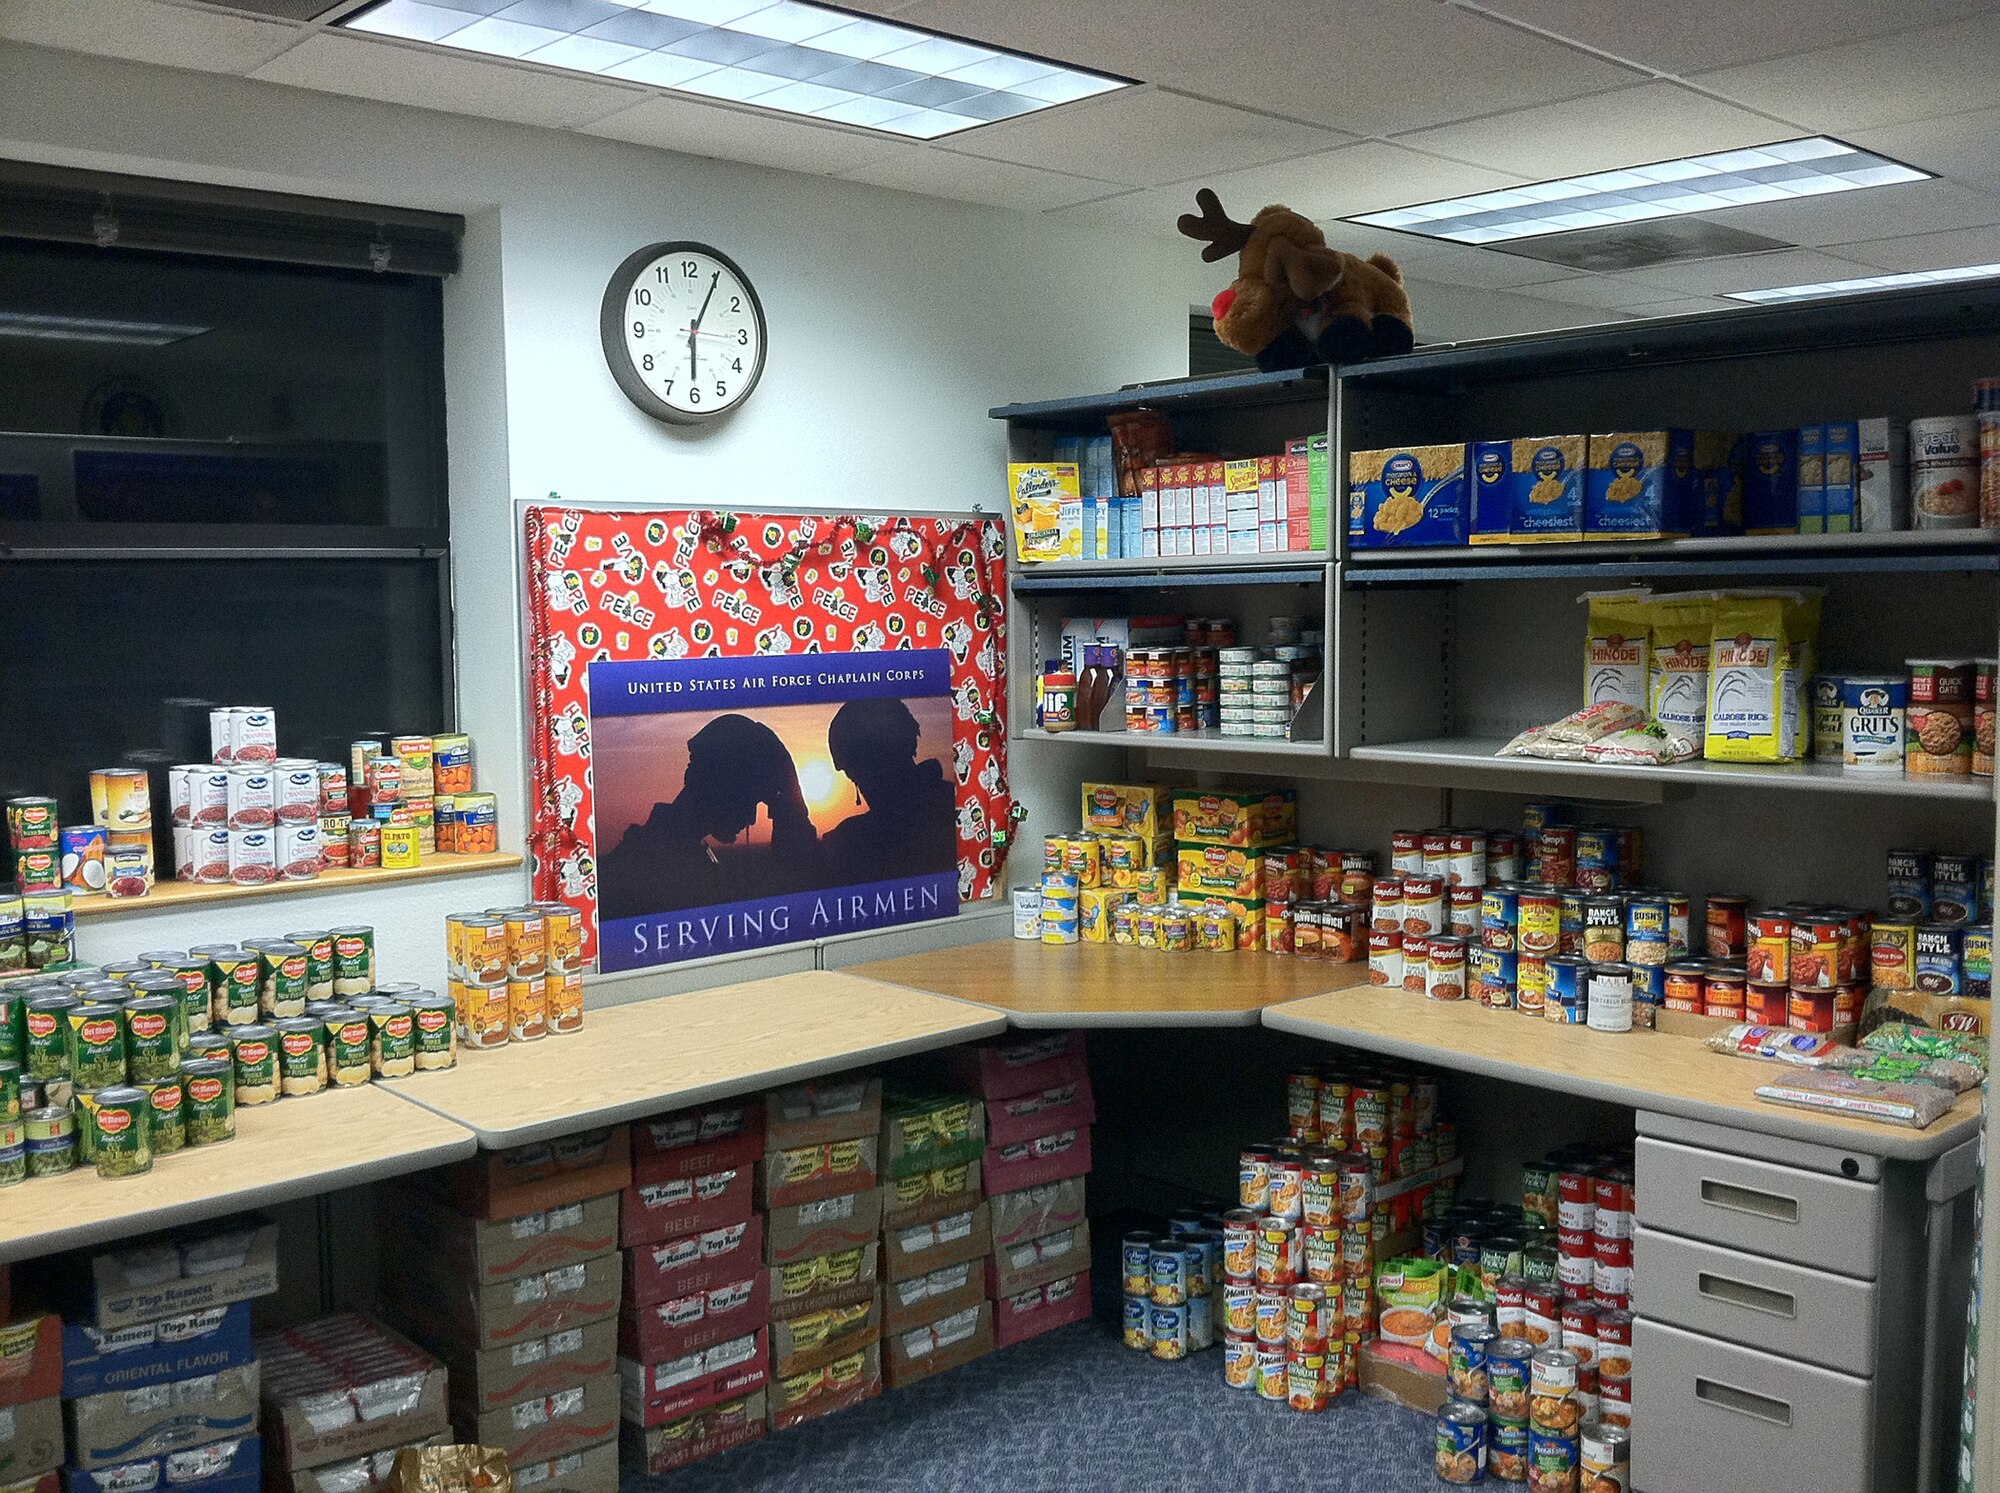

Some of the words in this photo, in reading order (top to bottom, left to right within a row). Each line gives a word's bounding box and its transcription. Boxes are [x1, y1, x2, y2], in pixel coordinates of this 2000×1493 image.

[656, 267, 669, 283] 11
[681, 261, 698, 278] 12
[635, 289, 651, 306] 10
[730, 296, 741, 313] 2
[633, 322, 645, 338] 9
[737, 329, 748, 345] 3
[643, 354, 654, 371] 8
[732, 357, 743, 374] 4
[664, 379, 674, 395] 7
[716, 381, 727, 396] 5
[690, 388, 700, 404] 6
[1915, 429, 1959, 446] Great
[1924, 443, 1961, 455] Value
[1428, 508, 1439, 518] 12
[1524, 516, 1574, 528] cheesiest
[713, 590, 759, 626] PEACE
[813, 589, 857, 621] PEACE
[905, 586, 946, 618] PEACE
[602, 593, 653, 628] PEACE
[1592, 649, 1639, 662] HINODE
[628, 681, 683, 696] UNITED
[689, 677, 736, 692] STATES
[742, 675, 766, 689] AIR
[772, 673, 813, 688] FORCE
[817, 670, 881, 686] CHAPLAIN
[886, 668, 925, 682] CORPS
[1939, 677, 1962, 686] QUICK
[1939, 685, 1959, 694] OATS
[1714, 712, 1746, 721] CALROSE
[1747, 713, 1769, 721] RICE
[1850, 716, 1899, 735] GRITS
[393, 832, 411, 840] PATO
[1404, 882, 1432, 895] Campbell's
[633, 905, 790, 954] SERVING
[810, 884, 940, 926] AIRMEN
[1294, 914, 1322, 923] ANWICH
[1588, 908, 1617, 917] RANCH
[1634, 910, 1663, 921] BUSH'S
[1587, 916, 1620, 926] STYLE
[1918, 933, 1947, 944] RANCH
[1429, 947, 1463, 960] Campbell's
[1917, 943, 1950, 954] STYLE
[1481, 957, 1499, 966] USH'S
[95, 1027, 115, 1035] Monte
[144, 1020, 164, 1029] Monte
[108, 1115, 129, 1123] Monte
[680, 1155, 714, 1172] BEEF
[656, 1187, 689, 1199] Ramen
[665, 1215, 700, 1233] BEEF
[666, 1249, 698, 1264] Ramen
[706, 1240, 724, 1249] Top
[677, 1274, 711, 1292] BEEF
[711, 1298, 729, 1307] Top
[161, 1321, 186, 1334] Top
[684, 1329, 717, 1348] BEEF
[105, 1362, 171, 1385] ORIENTAL
[177, 1351, 229, 1371] FLAVOR
[693, 1437, 716, 1455] BEEF
